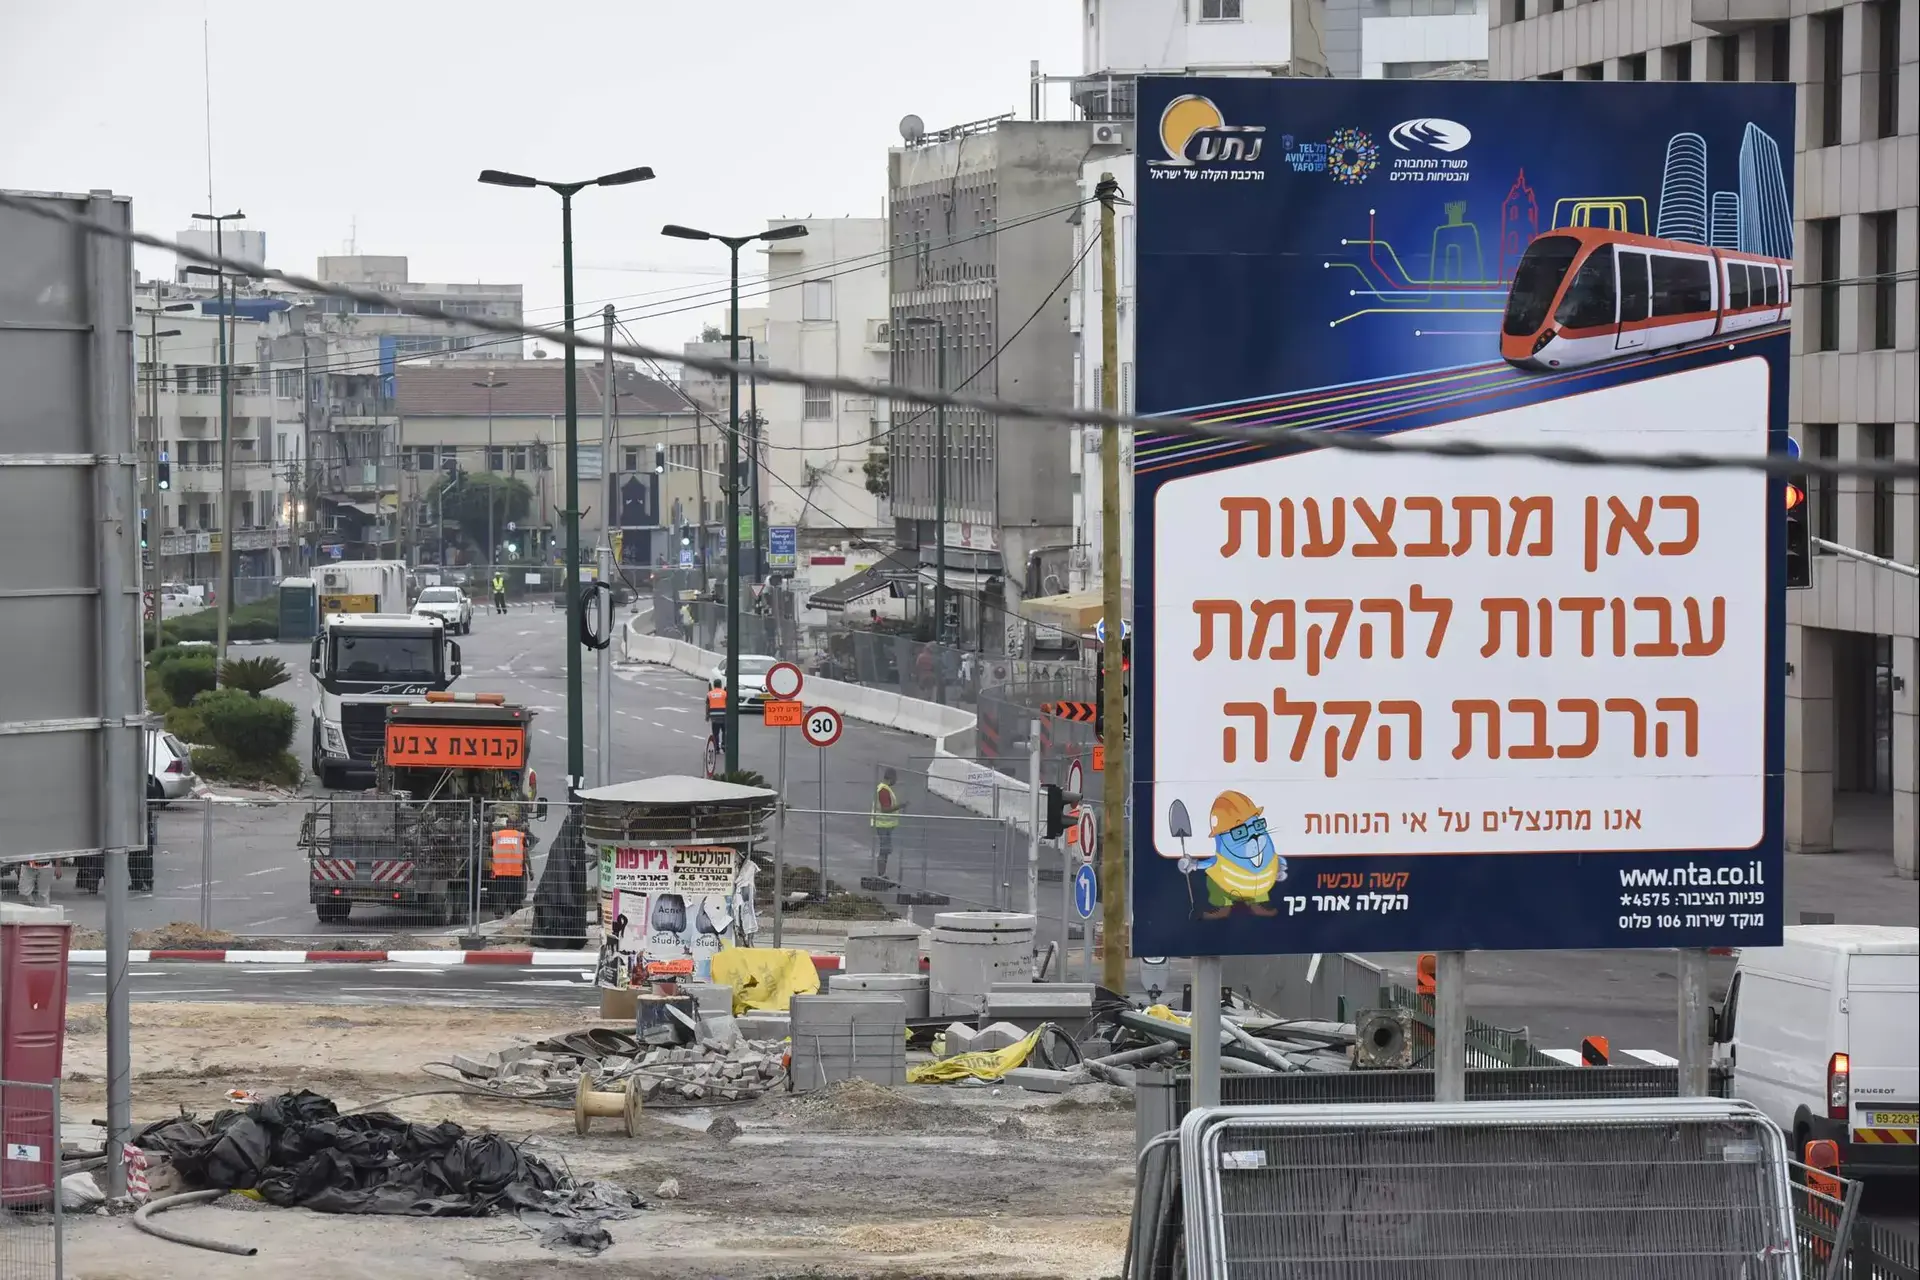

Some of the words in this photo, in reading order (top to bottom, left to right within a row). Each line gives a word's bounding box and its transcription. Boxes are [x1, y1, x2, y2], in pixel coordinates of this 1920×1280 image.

[1196, 137, 1262, 160] נתע
[1299, 143, 1314, 153] TEL
[1285, 153, 1305, 162] AVIV
[1394, 159, 1438, 168] התחבורה
[1441, 159, 1468, 169] משרד
[1150, 168, 1181, 180] ישראל
[1184, 169, 1198, 179] של
[1200, 169, 1228, 182] הקלה
[1230, 170, 1265, 180] הרכבת
[1292, 163, 1314, 172] YAFO
[1390, 171, 1424, 182] בדרכים
[1426, 172, 1469, 182] והבטיחות
[1220, 496, 1553, 558] מתבצעות
[1583, 495, 1699, 572] כאן
[1192, 583, 1453, 676] להקמת
[1480, 595, 1726, 659] עבודות
[811, 718, 833, 733] 30
[1222, 687, 1422, 778] הקלה
[1451, 697, 1698, 760] הרכבת
[393, 735, 437, 755] צבע
[449, 737, 519, 759] קבוצת
[1304, 811, 1390, 835] הנוחות
[1402, 811, 1428, 833] אי
[1437, 807, 1470, 833] על
[1482, 805, 1591, 832] מתנצלים
[1603, 808, 1642, 831] אנו
[676, 848, 731, 866] הקולקטיב
[1317, 872, 1364, 889] עכשיו
[1369, 871, 1409, 891] קשה
[1619, 860, 1764, 887] www.nta.co.il
[1284, 895, 1306, 916] כך
[1312, 894, 1350, 912] אחר
[1356, 892, 1409, 914] הקלה
[1675, 892, 1724, 906] הציבור:
[1729, 891, 1764, 905] פניות
[1619, 913, 1651, 928] פלוס
[1657, 915, 1681, 928] 106
[1686, 914, 1725, 927] שירות
[1730, 913, 1764, 929] מוקד
